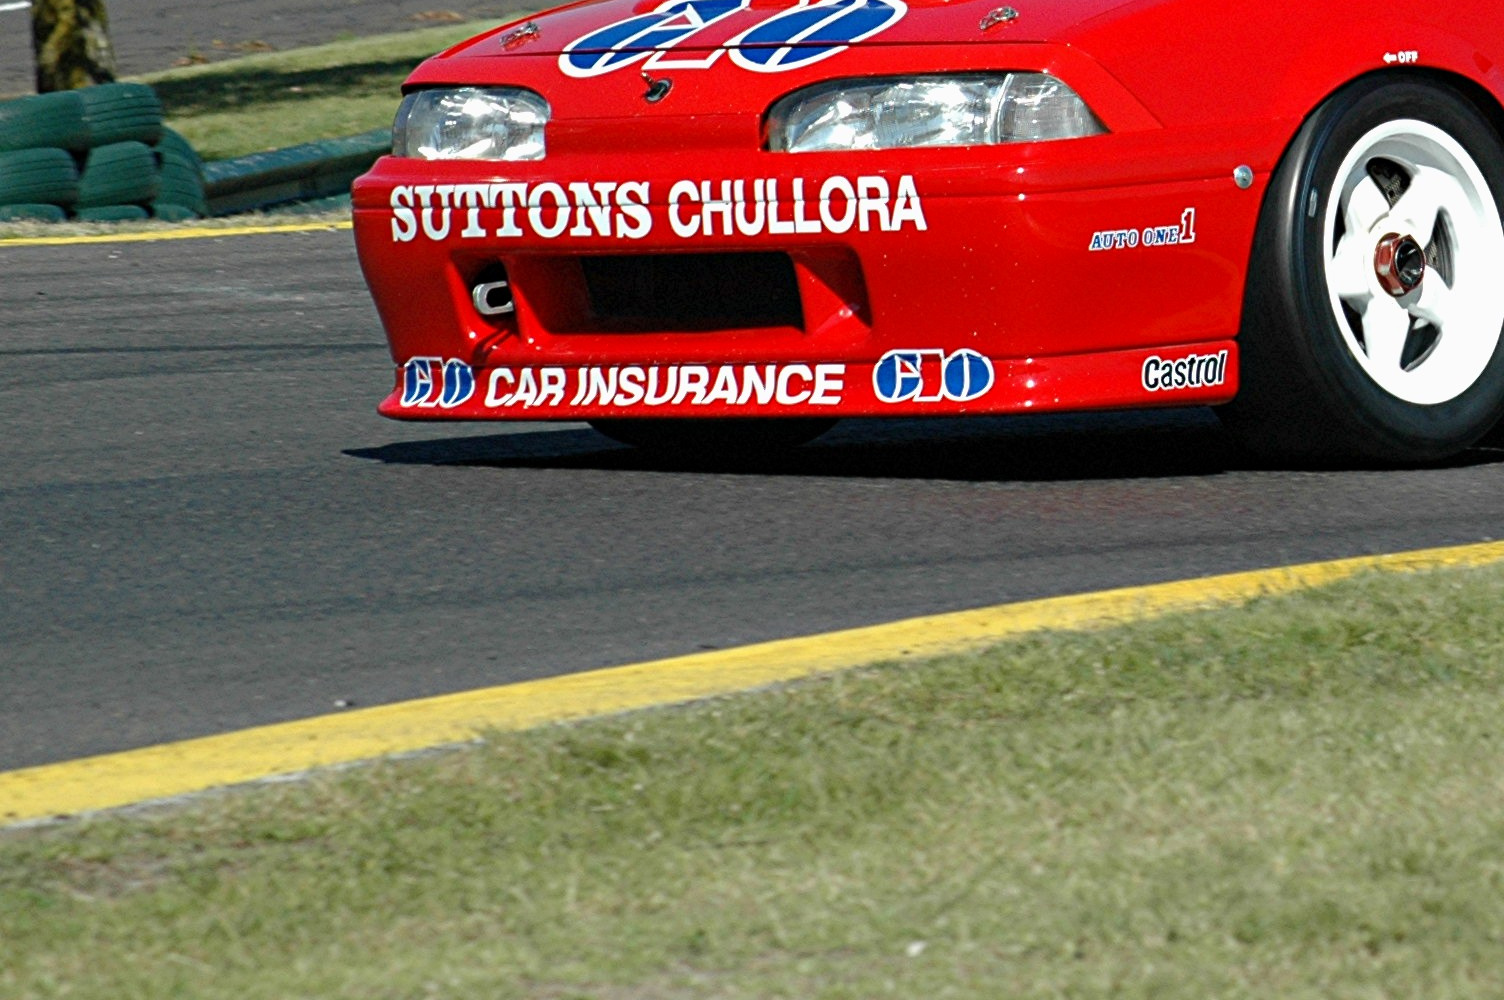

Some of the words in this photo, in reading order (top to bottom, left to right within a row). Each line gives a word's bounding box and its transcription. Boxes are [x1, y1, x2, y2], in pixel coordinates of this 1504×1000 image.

[1397, 50, 1418, 63] OFF
[390, 180, 653, 243] SUTTONS
[667, 174, 928, 238] CHULLORA
[1089, 228, 1139, 251] AUTO
[1142, 225, 1180, 247] ONE
[1179, 207, 1196, 243] 1
[483, 366, 566, 409] CAR
[569, 362, 846, 407] INSURANCE
[1141, 349, 1229, 392] Castrol
